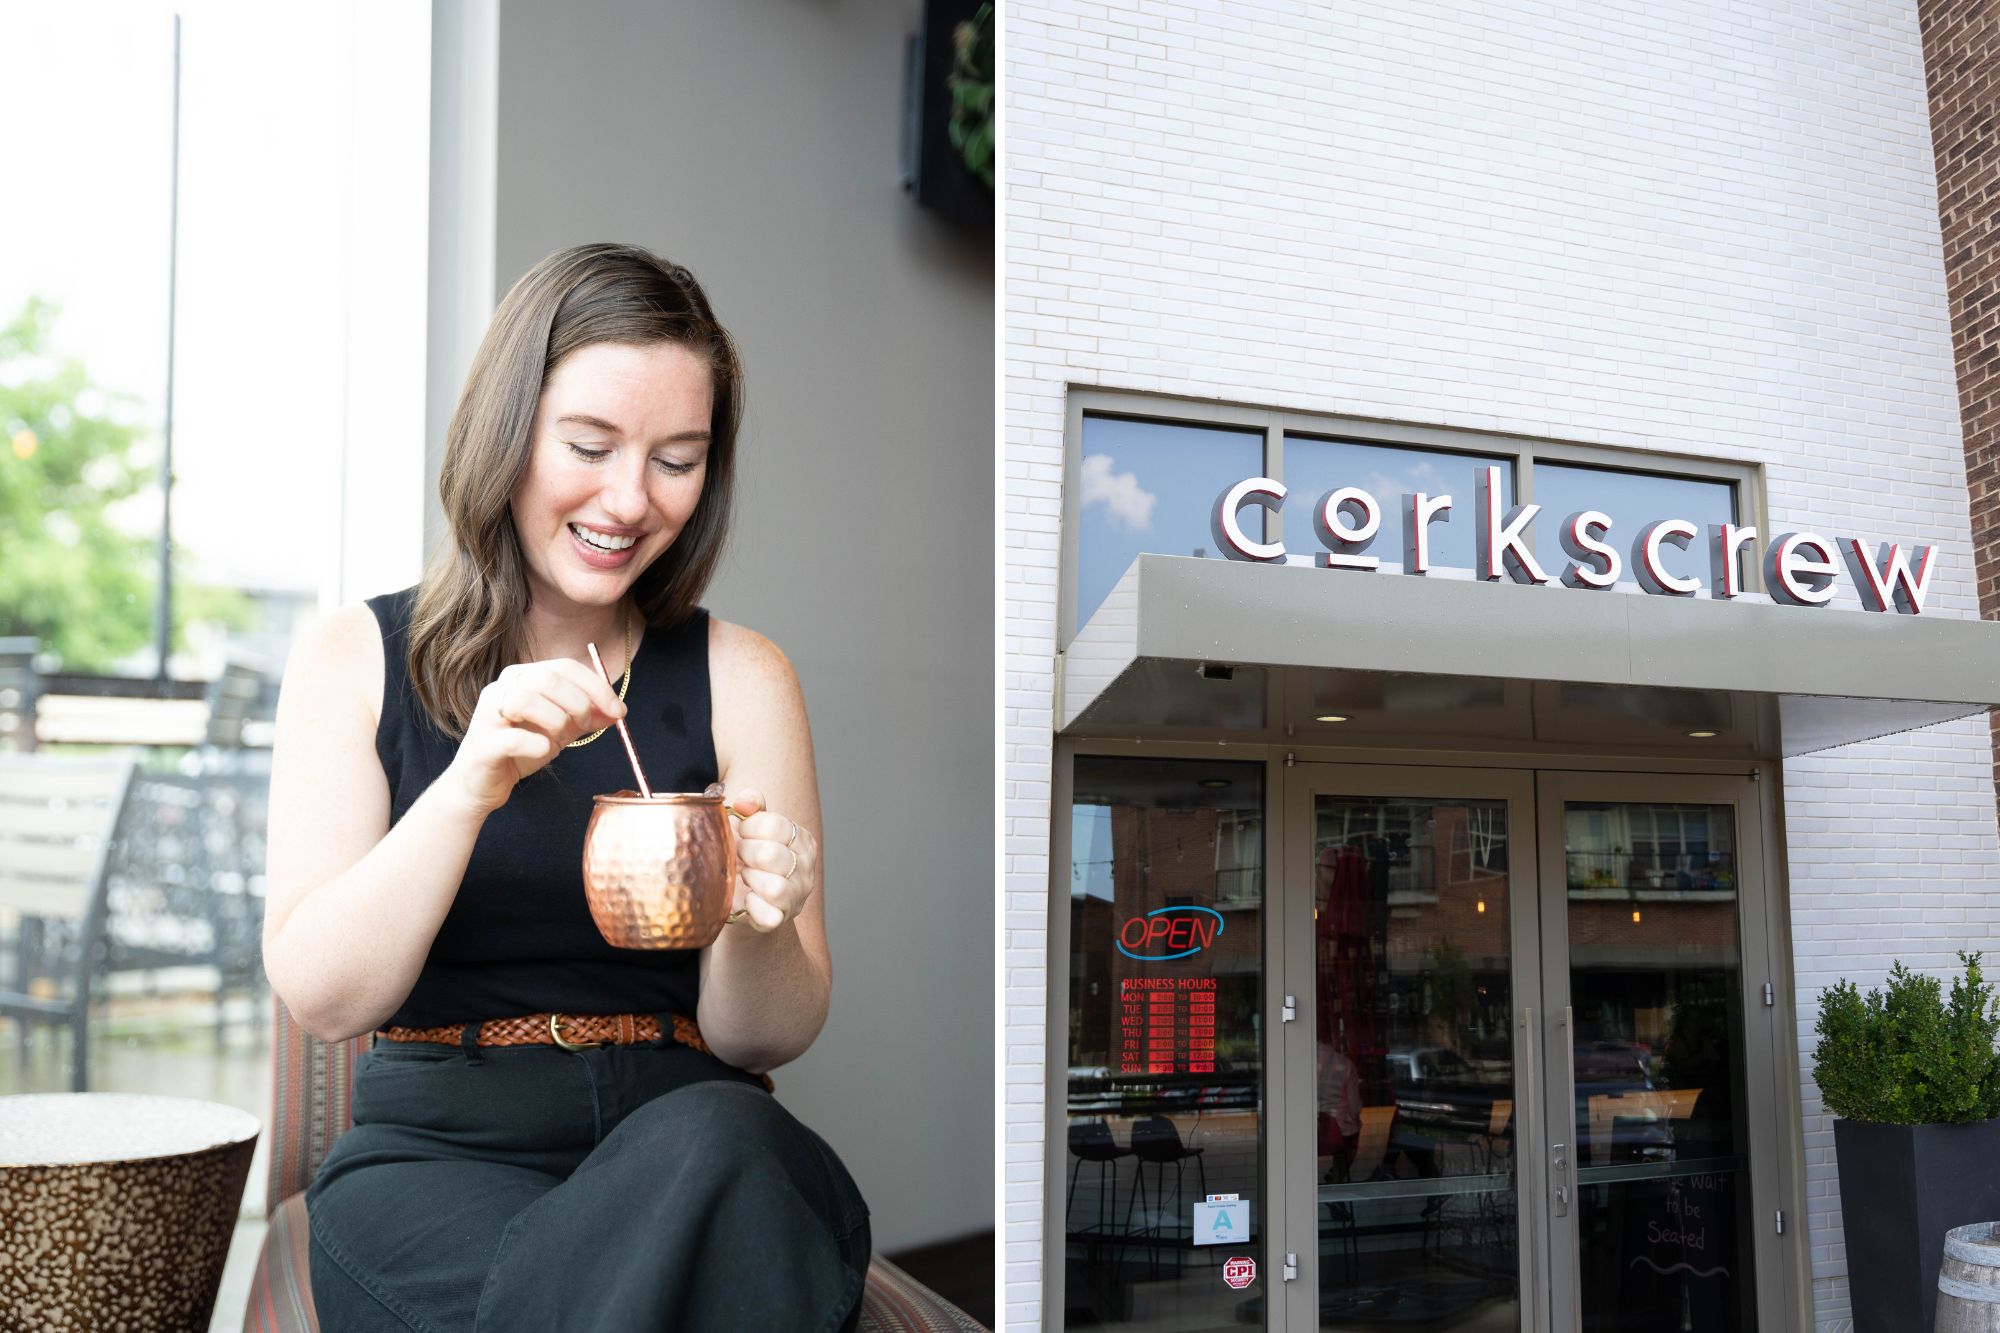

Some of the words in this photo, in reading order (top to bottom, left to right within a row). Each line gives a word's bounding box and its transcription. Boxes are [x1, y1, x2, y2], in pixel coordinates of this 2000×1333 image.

[1212, 466, 1938, 614] corkscrew
[1121, 917, 1216, 948] OPEN
[1123, 978, 1175, 990] BUSINESS
[1178, 978, 1217, 990] HOURS
[1121, 992, 1144, 1001] MON
[1123, 1004, 1142, 1014] TUE
[1177, 1005, 1187, 1013] TO
[1121, 1016, 1143, 1026] WED
[1177, 1017, 1187, 1025] TO
[1122, 1028, 1142, 1038] THU
[1177, 1029, 1187, 1037] TO
[1123, 1040, 1139, 1049] FRI
[1122, 1052, 1140, 1061] SAT
[1121, 1063, 1141, 1073] SUN
[1664, 1193, 1679, 1214] to
[1684, 1194, 1702, 1218] be
[1212, 1209, 1233, 1230] A
[1647, 1220, 1705, 1250] Seated
[1226, 1265, 1253, 1277] CPI
